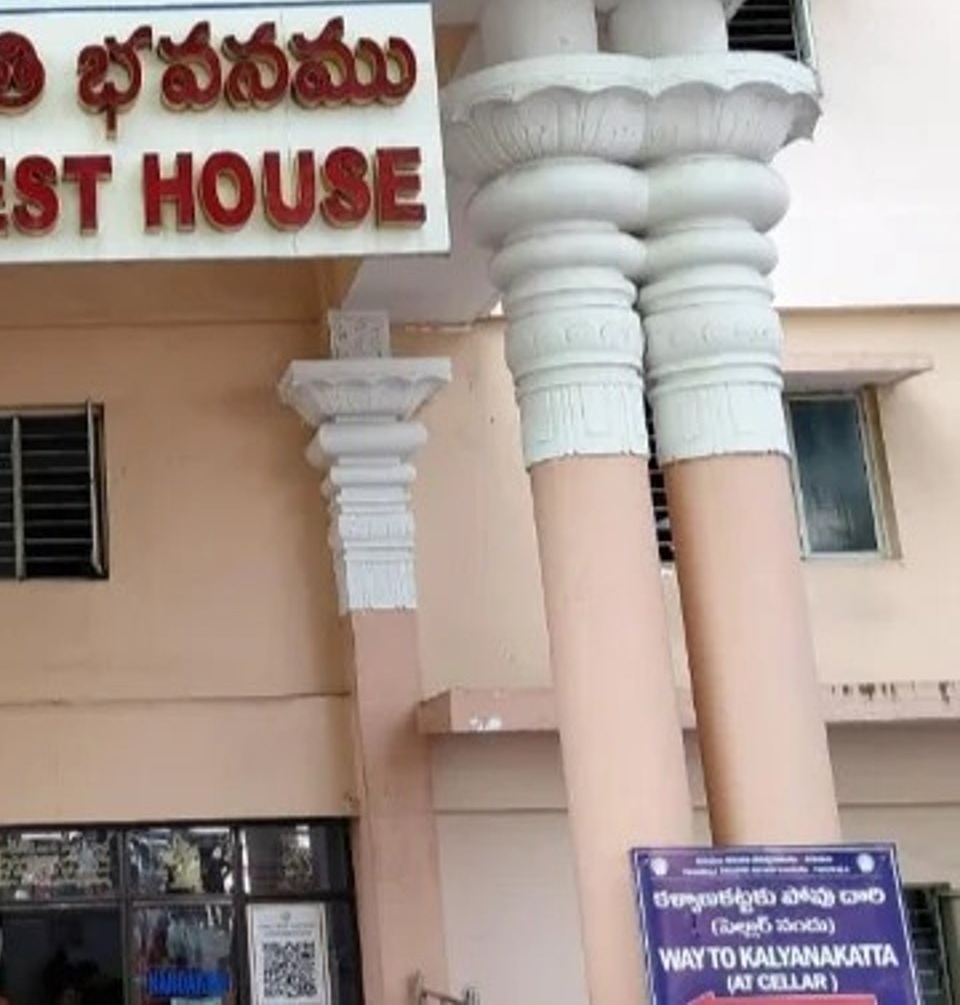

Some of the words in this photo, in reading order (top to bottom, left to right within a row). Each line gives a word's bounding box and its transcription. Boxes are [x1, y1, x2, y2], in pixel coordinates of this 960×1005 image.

[76, 16, 417, 140] భవనము
[142, 146, 427, 233] HOUSE
[659, 947, 708, 971] WAY
[707, 947, 736, 969] TO
[740, 943, 899, 969] KALYANAKATTA
[727, 973, 753, 994] (AT
